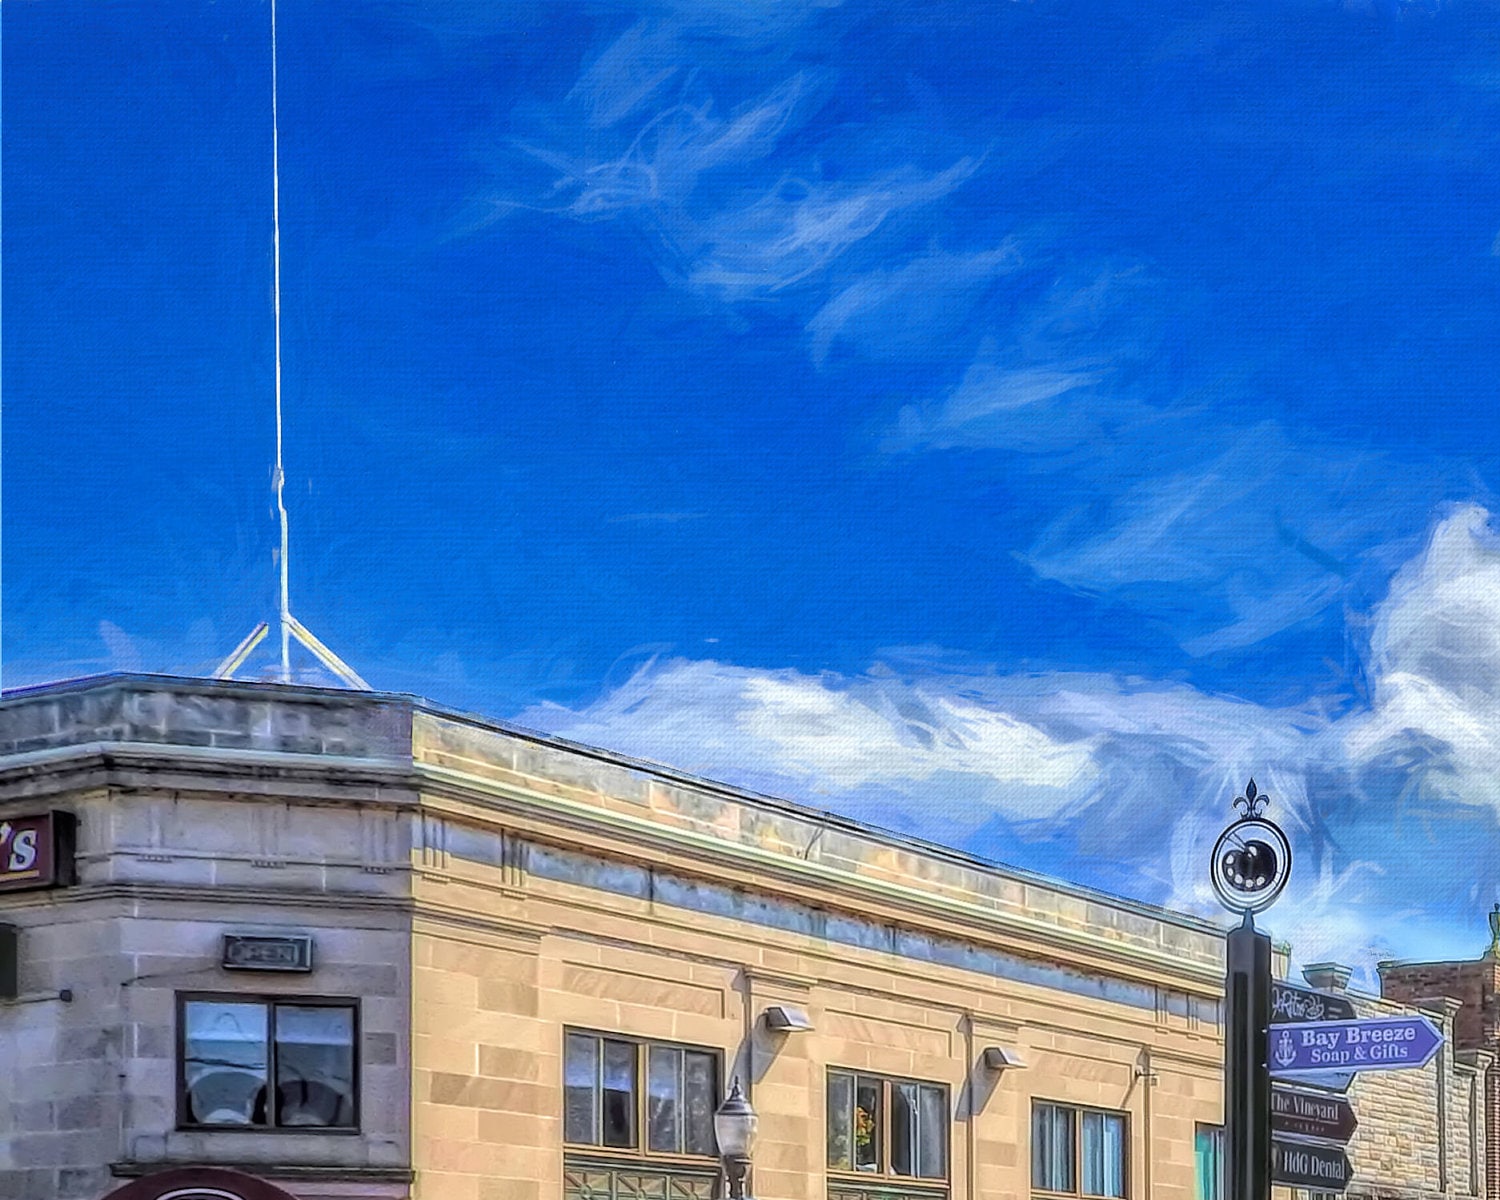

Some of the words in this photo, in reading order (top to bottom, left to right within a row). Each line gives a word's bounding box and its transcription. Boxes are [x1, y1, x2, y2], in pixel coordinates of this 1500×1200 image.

[1301, 1029, 1340, 1050] Bay
[1346, 1026, 1416, 1045] Breeze
[1311, 1048, 1350, 1064] Soap
[1354, 1049, 1367, 1061] &
[1370, 1044, 1408, 1060] Gifts
[1311, 1155, 1345, 1181] Dental
